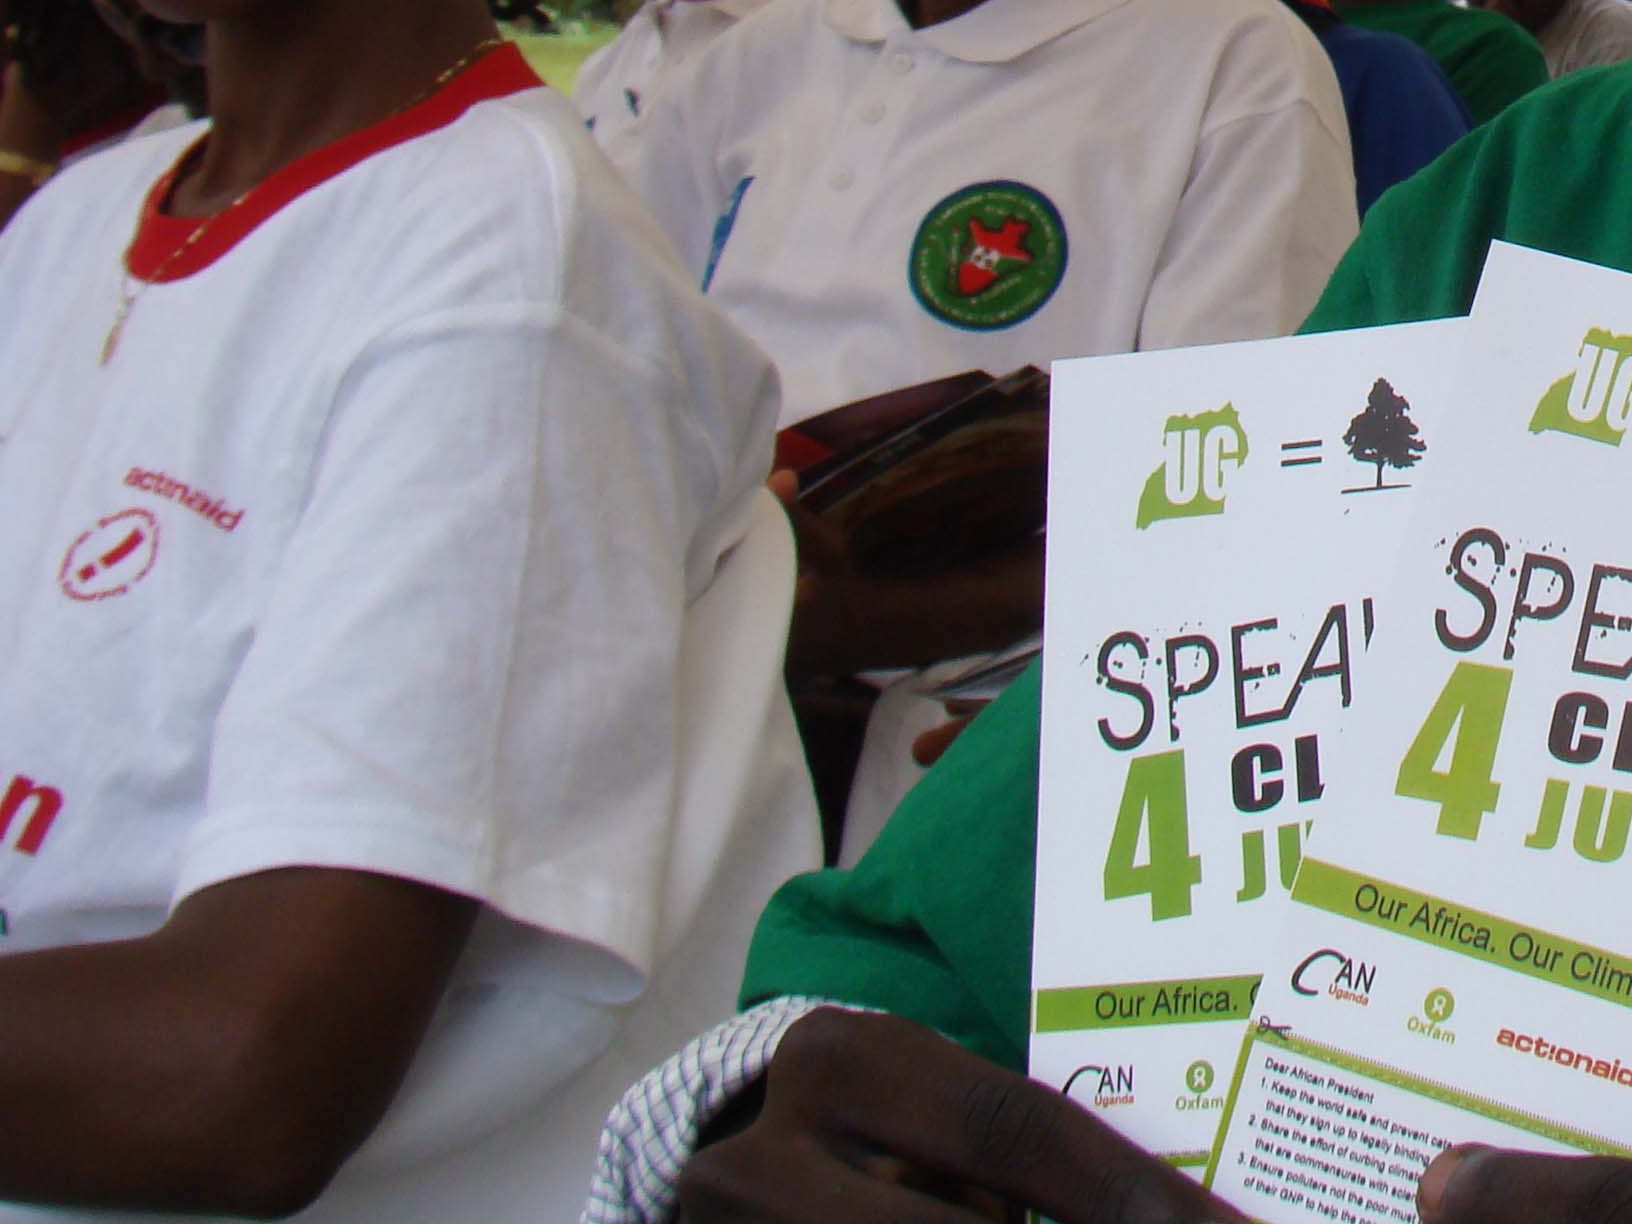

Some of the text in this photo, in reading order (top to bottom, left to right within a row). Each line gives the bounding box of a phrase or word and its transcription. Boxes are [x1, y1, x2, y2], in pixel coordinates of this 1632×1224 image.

[1164, 426, 1240, 505] UG
[1096, 597, 1376, 752] SPEA
[1394, 660, 1502, 842] 4
[1102, 748, 1202, 923] 4
[1354, 882, 1408, 923] Our
[1410, 900, 1497, 954] Africa.
[1508, 931, 1564, 973] Our
[1291, 947, 1377, 996] CAN
[1327, 983, 1371, 1007] Uganda
[1094, 984, 1238, 1022] Our Africa.
[1406, 1015, 1457, 1045] Oxfam
[1094, 1094, 1135, 1109] Uganda
[1175, 1095, 1224, 1111] Oxfam
[1264, 1056, 1375, 1104] Dear African President
[1265, 1099, 1431, 1168] that they sign up to legally binding
[1271, 1079, 1298, 1099] Keep
[1299, 1089, 1315, 1105] the
[1317, 1097, 1345, 1115] world
[1369, 1116, 1390, 1130] and
[1390, 1122, 1430, 1144] prevent
[1255, 1137, 1275, 1153] that
[1275, 1146, 1292, 1160] are
[1293, 1152, 1366, 1186] commensurate
[1368, 1178, 1389, 1195] with
[1260, 1117, 1290, 1138] Share
[1291, 1128, 1308, 1145] the
[1310, 1136, 1336, 1154] effort
[1337, 1145, 1349, 1158] of
[1349, 1151, 1386, 1174] curbing
[1243, 1175, 1256, 1188] of
[1255, 1178, 1278, 1197] their
[1305, 1197, 1316, 1211] to
[1317, 1201, 1340, 1220] help
[1249, 1154, 1284, 1178] Ensure
[1285, 1171, 1328, 1194] polluters
[1329, 1186, 1346, 1202] not
[1347, 1191, 1364, 1207] the
[1365, 1199, 1390, 1216] poor
